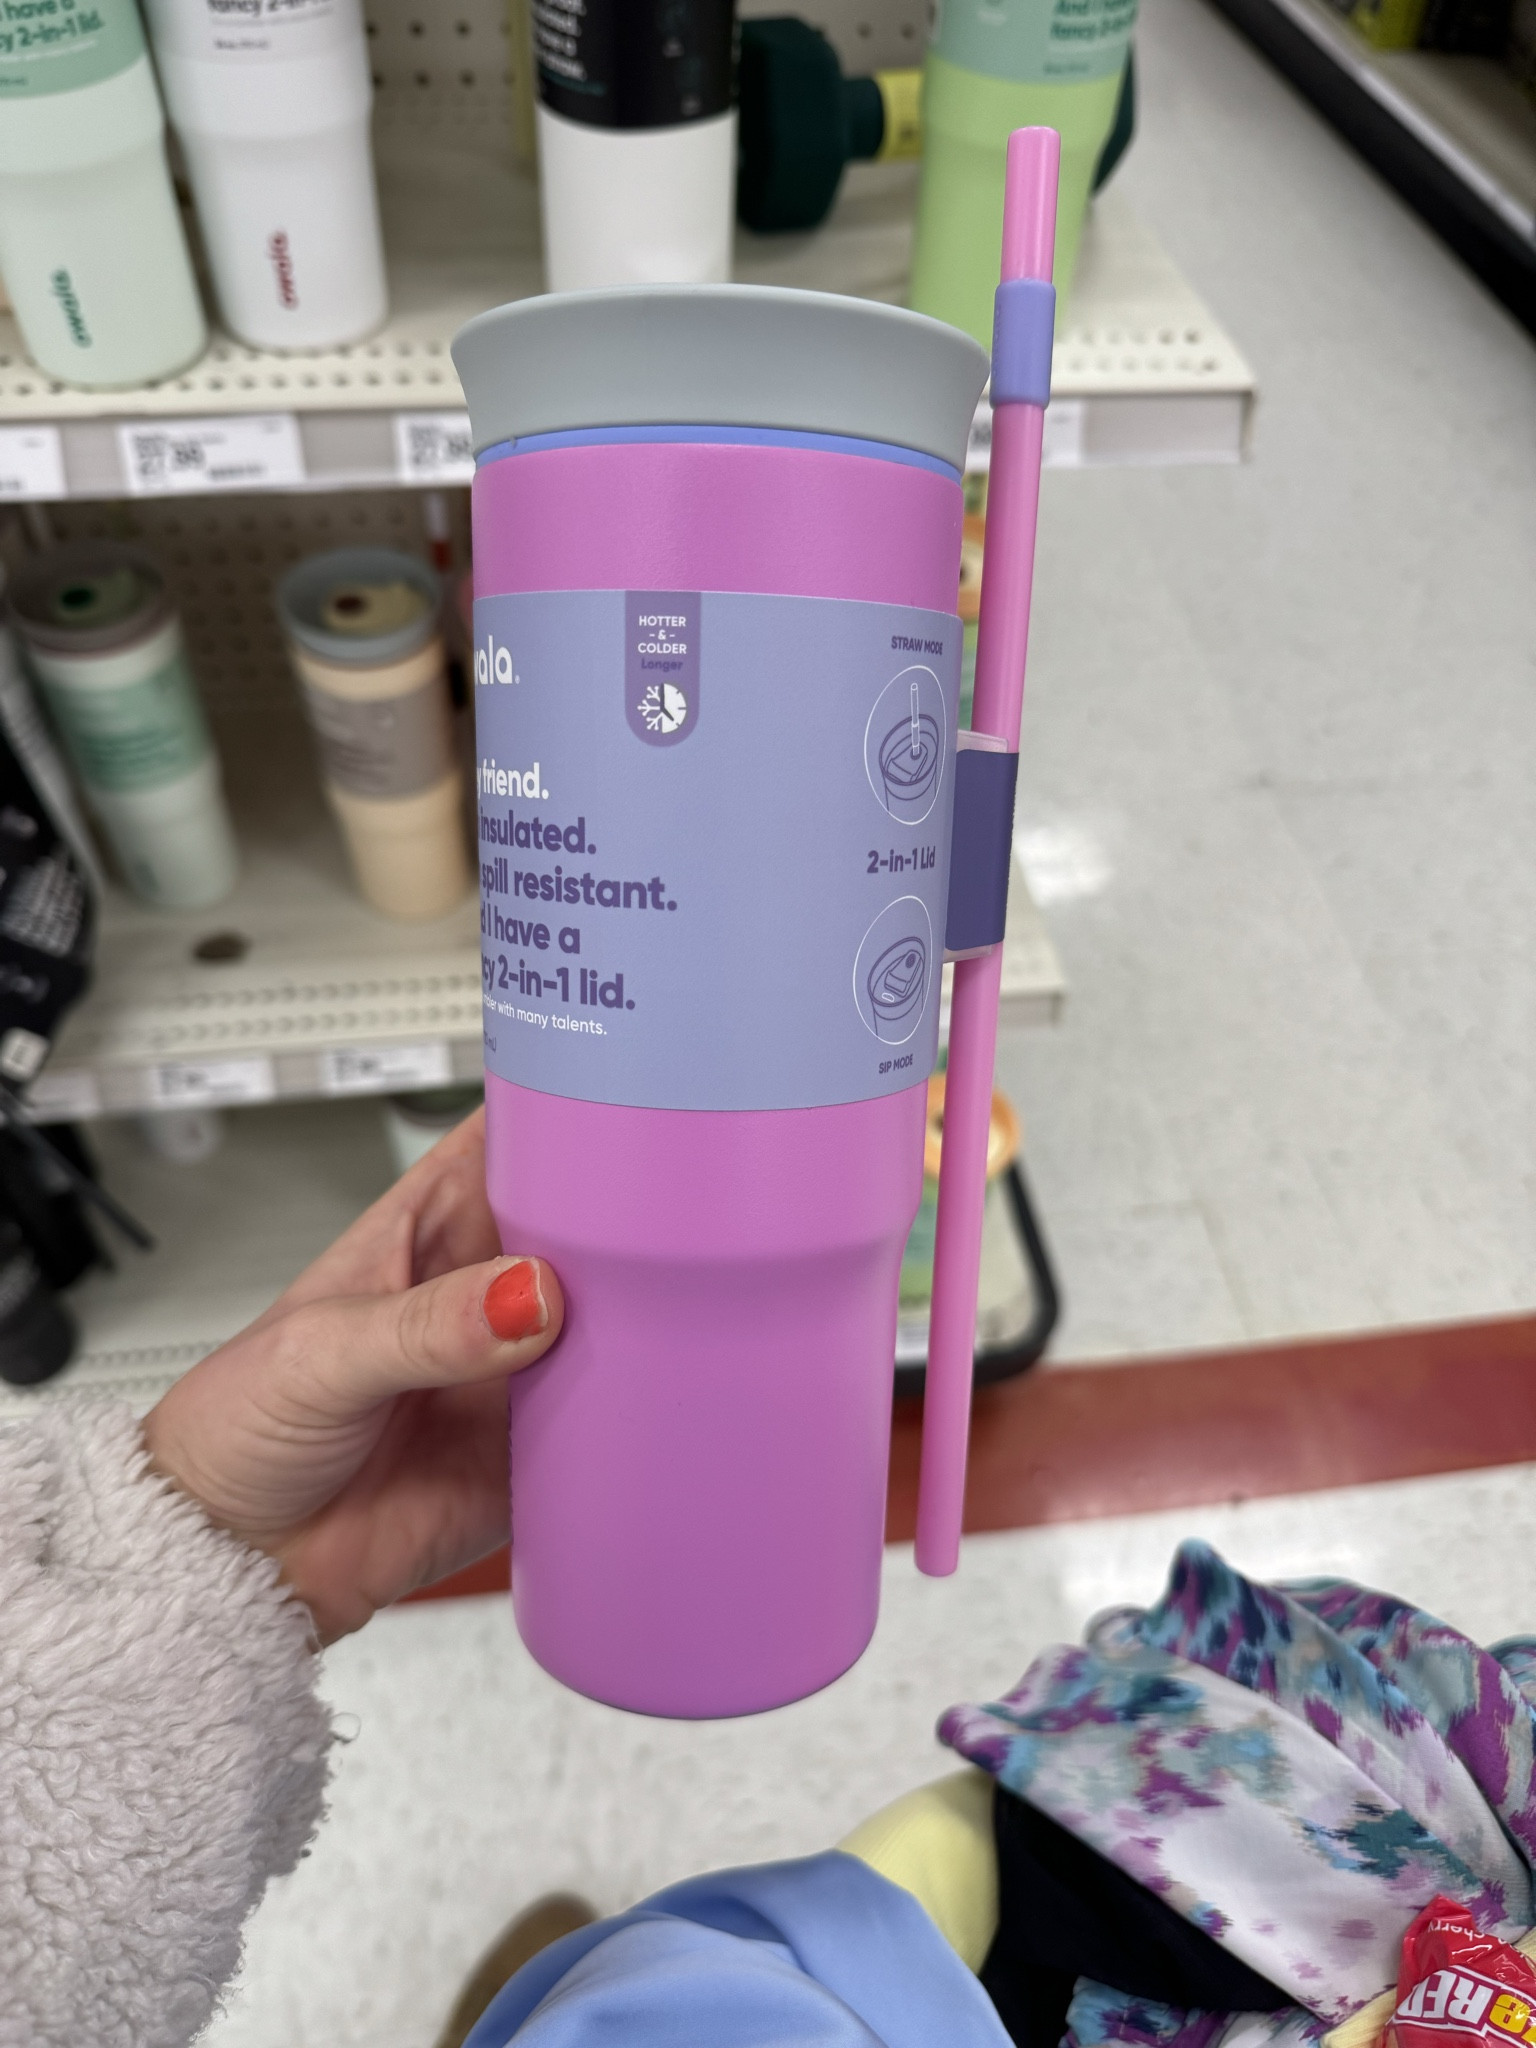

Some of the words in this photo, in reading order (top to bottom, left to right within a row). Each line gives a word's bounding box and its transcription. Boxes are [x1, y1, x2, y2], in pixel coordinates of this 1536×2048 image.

[638, 615, 687, 627] HOTTER
[637, 643, 687, 655] COLDER
[891, 635, 923, 652] STRAW
[924, 639, 943, 656] MODE
[641, 659, 684, 672] Longer
[483, 758, 549, 800] friend.
[481, 806, 597, 855] insulated.
[867, 848, 918, 874] 2-in-1
[920, 845, 936, 869] Lid
[482, 857, 508, 898] spill
[514, 865, 678, 912] resistant.
[494, 906, 551, 950] have
[558, 926, 581, 954] a
[498, 954, 570, 1003] 2-in-1
[579, 967, 636, 1011] lid.
[497, 1001, 515, 1018] with
[517, 1008, 548, 1029] many
[551, 1014, 608, 1036] talents.
[878, 1061, 892, 1075] SIP
[893, 1053, 914, 1071] MODE
